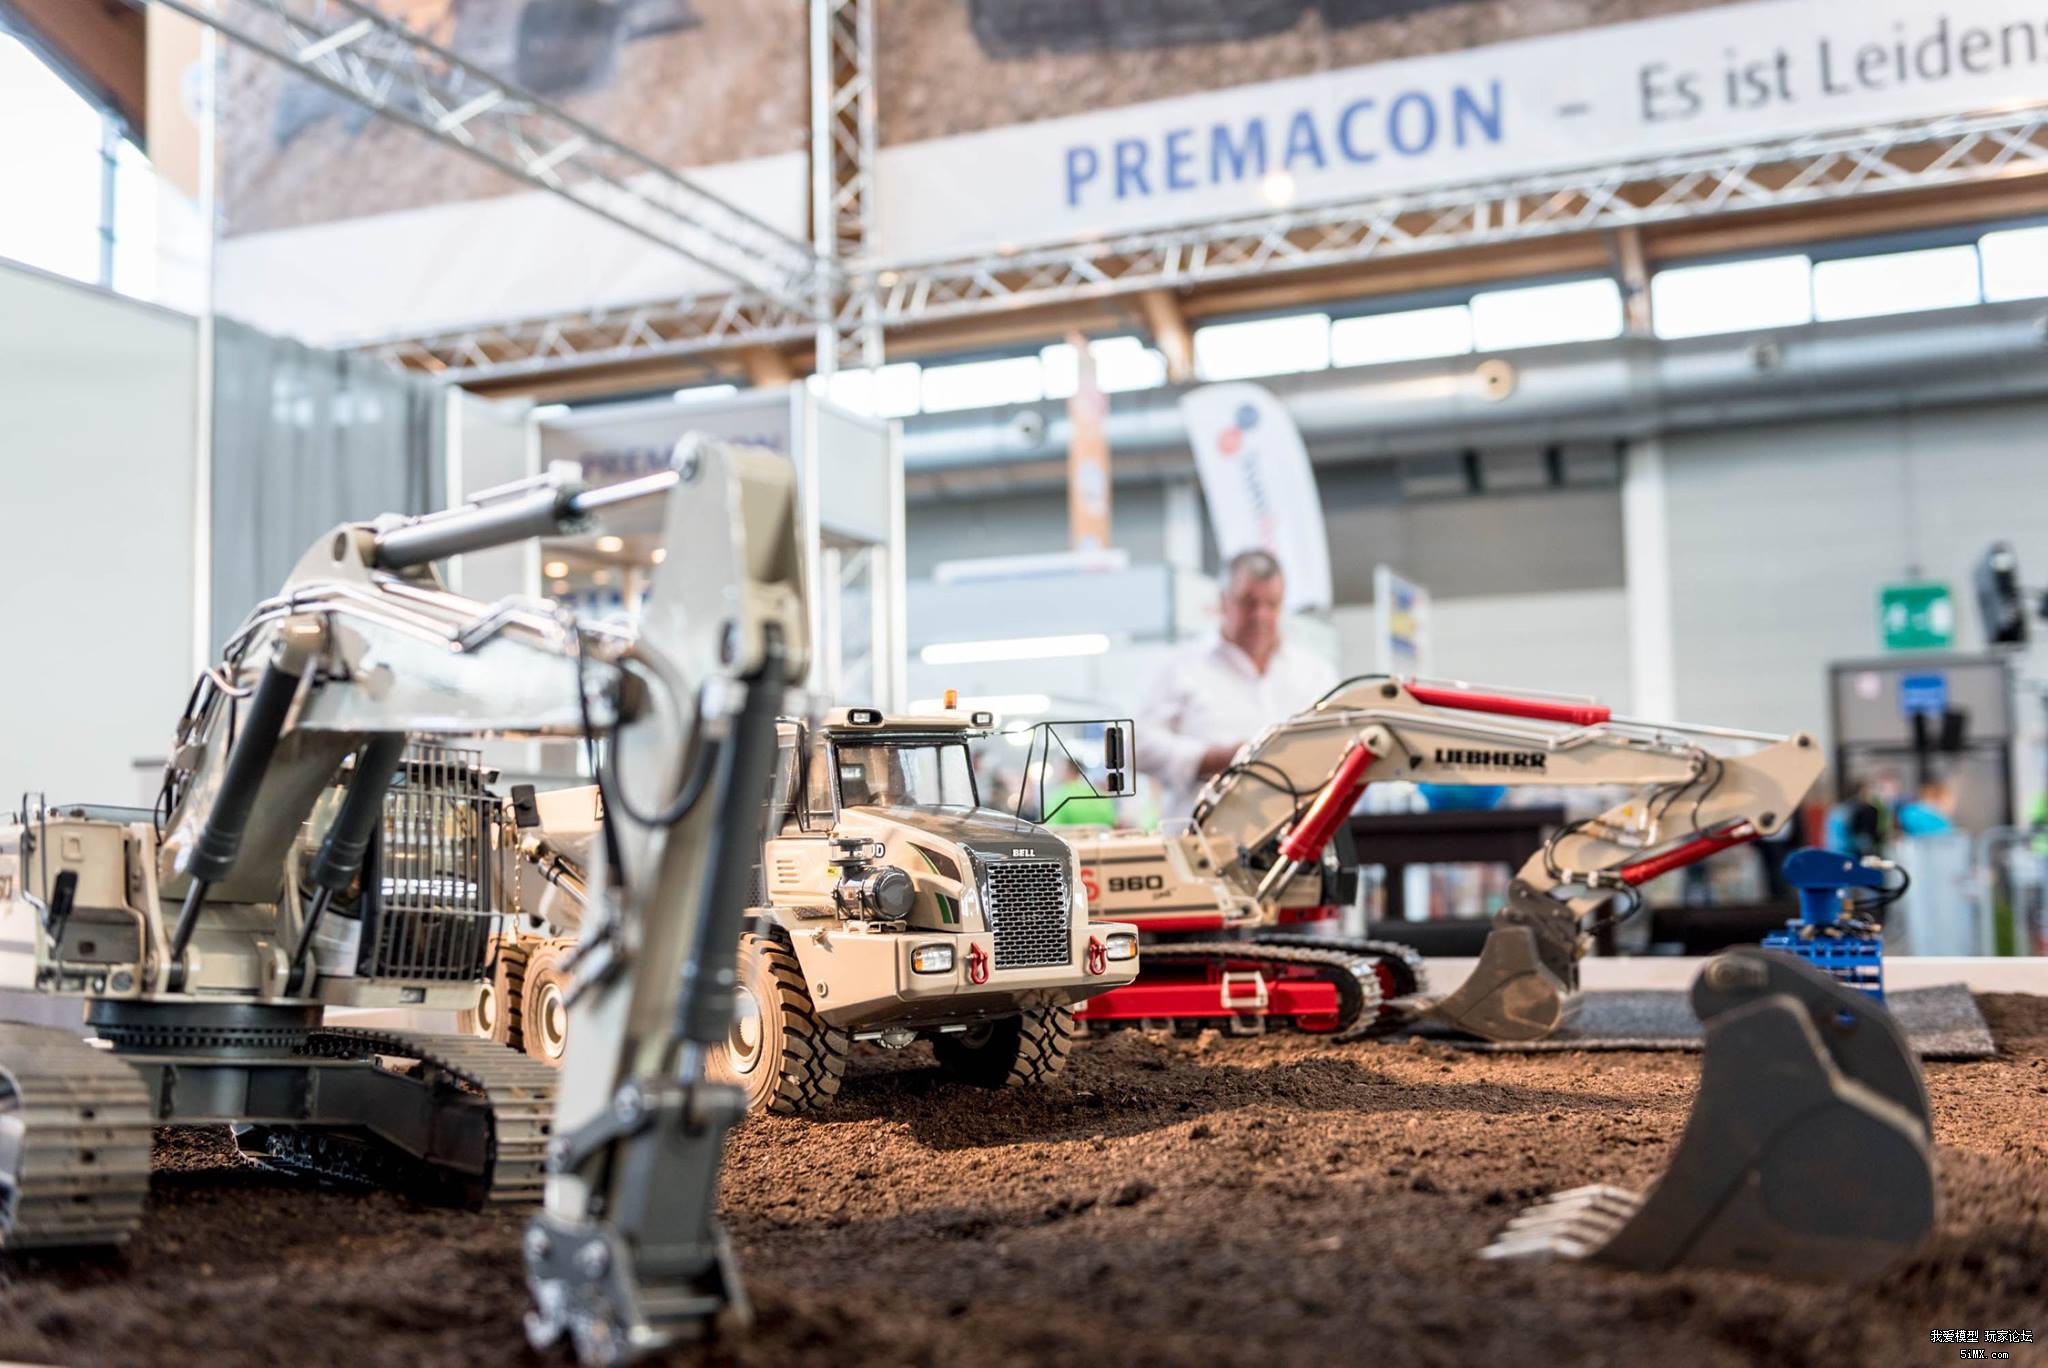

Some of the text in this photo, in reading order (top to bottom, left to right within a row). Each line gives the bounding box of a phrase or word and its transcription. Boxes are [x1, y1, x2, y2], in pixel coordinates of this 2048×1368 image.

[1066, 78, 1505, 207] PREMACON
[1638, 60, 1703, 122] Es
[1724, 47, 1793, 108] ist
[1818, 15, 2048, 96] Leiden
[1435, 748, 1546, 767] LIEBHERR
[1012, 848, 1036, 858] BELL
[1108, 875, 1164, 892] 960
